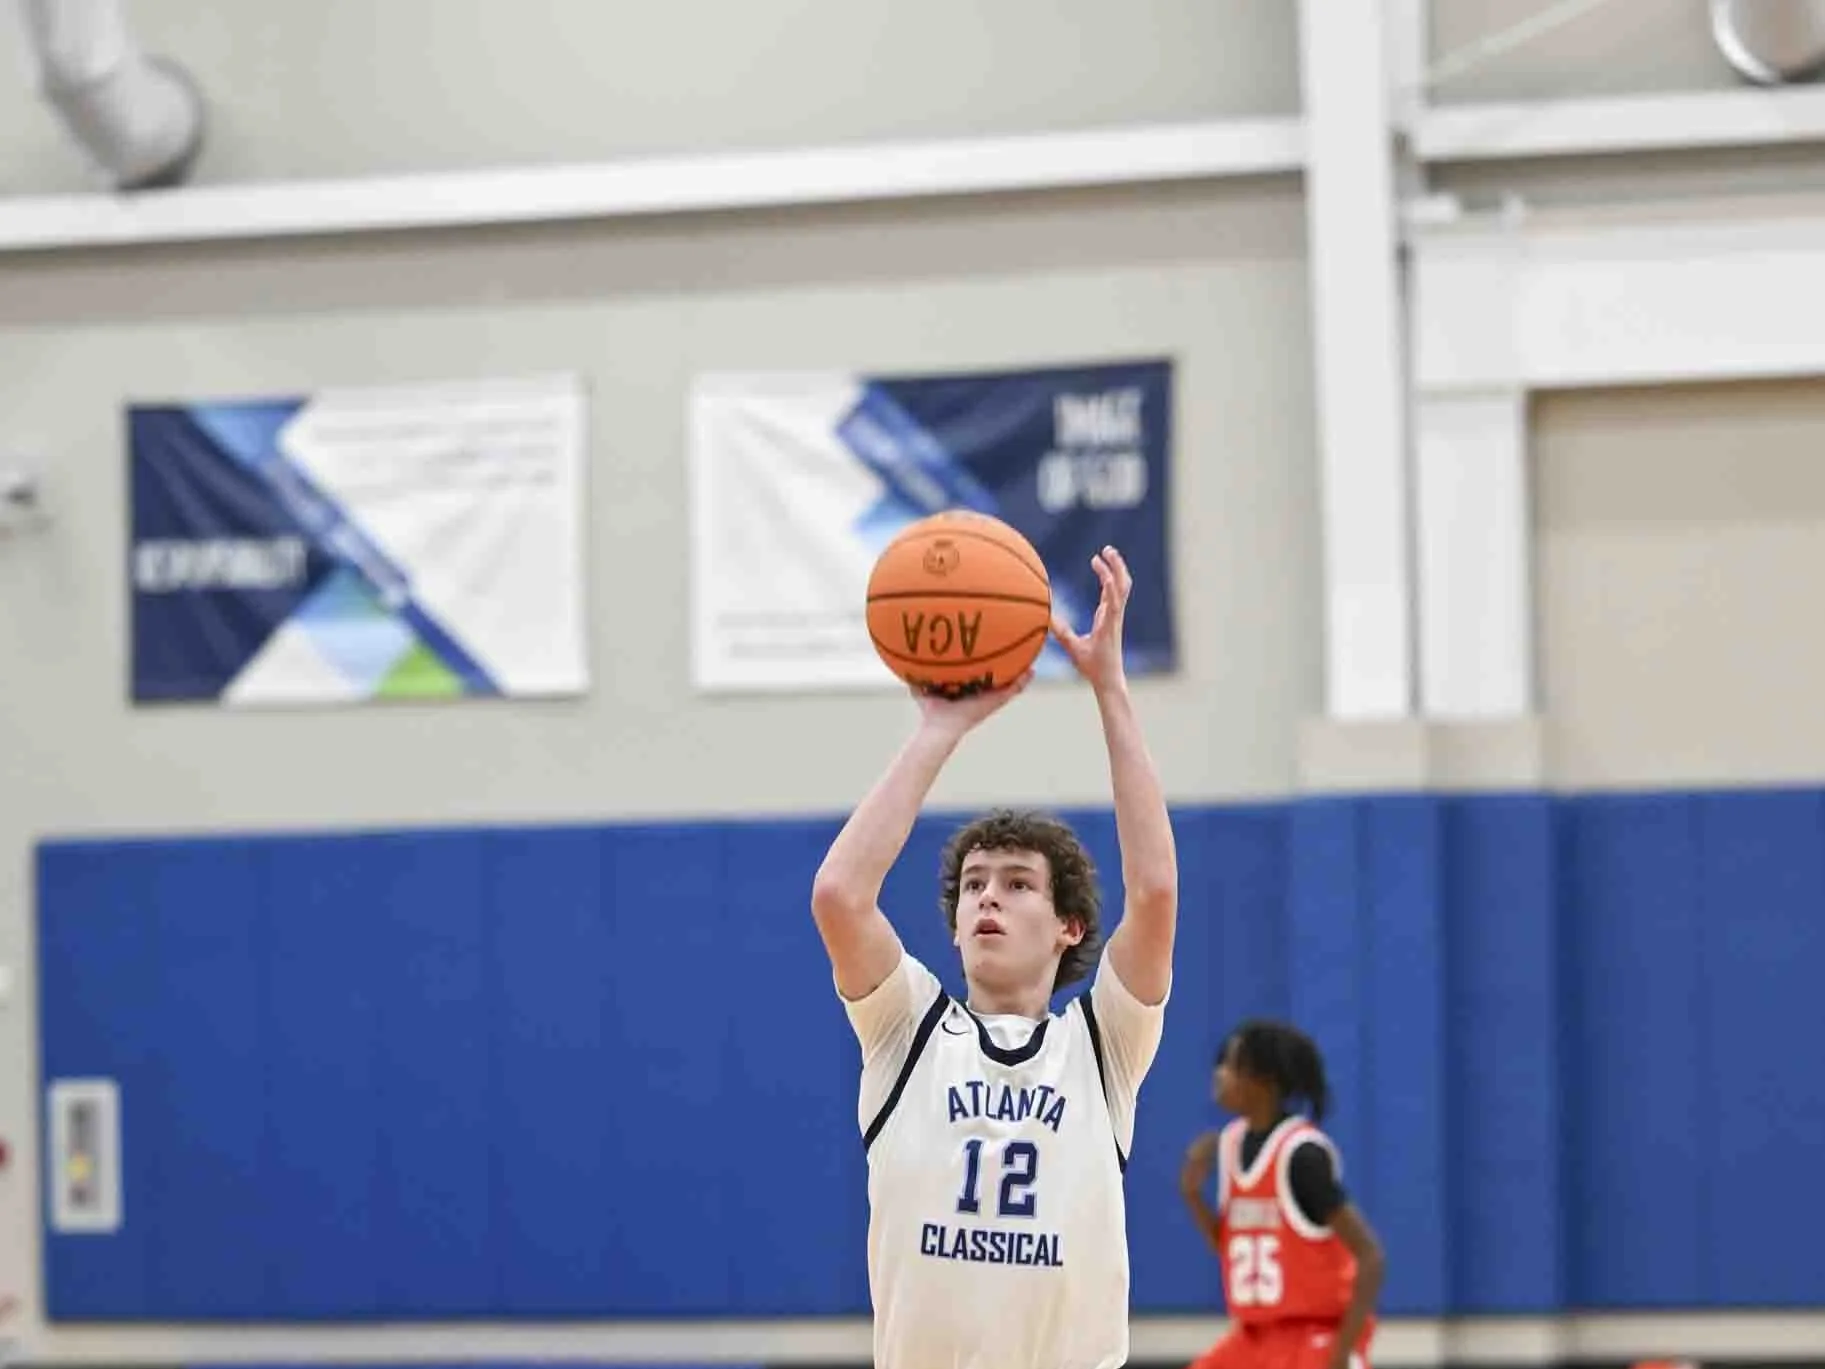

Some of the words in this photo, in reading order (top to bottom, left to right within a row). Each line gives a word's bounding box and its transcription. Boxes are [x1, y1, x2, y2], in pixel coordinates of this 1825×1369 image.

[902, 610, 982, 657] ACA
[948, 1080, 1066, 1133] ATLANTA
[956, 1138, 1039, 1218] 12
[920, 1223, 1064, 1266] CLASSICAL
[1228, 1234, 1283, 1306] 25
